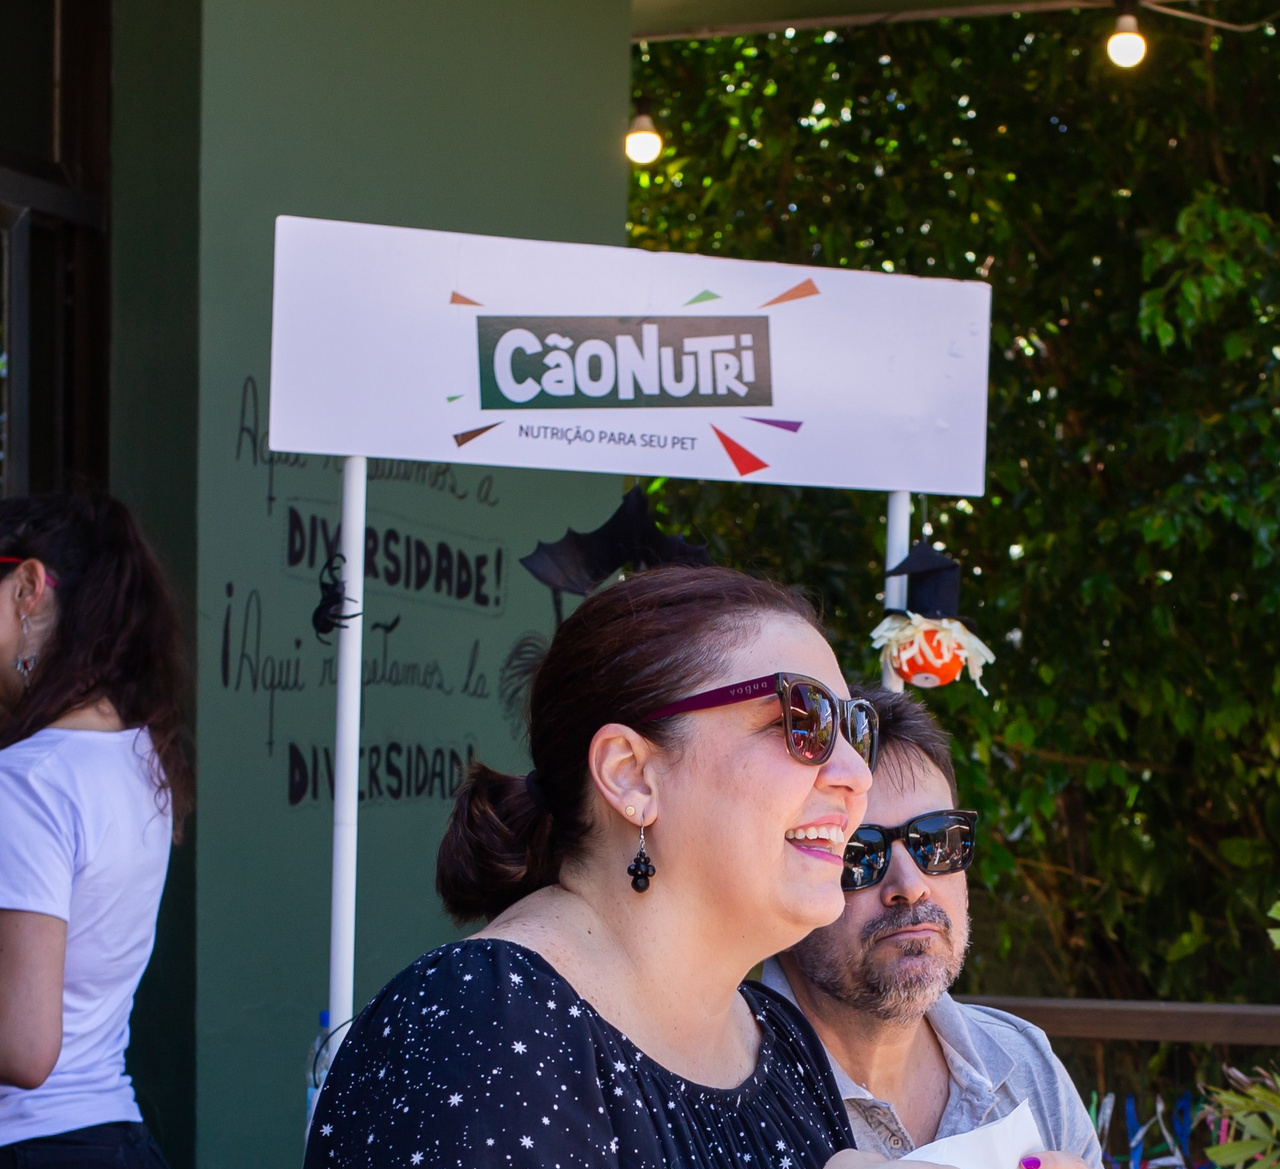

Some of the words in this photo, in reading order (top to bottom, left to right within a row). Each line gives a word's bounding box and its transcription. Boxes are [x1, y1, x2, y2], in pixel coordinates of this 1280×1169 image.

[519, 425, 595, 445] NUTRIÇÃO
[600, 430, 636, 447] PARA
[640, 433, 667, 448] SEU
[672, 436, 698, 450] PET
[287, 505, 503, 607] DIVRSIDADE!
